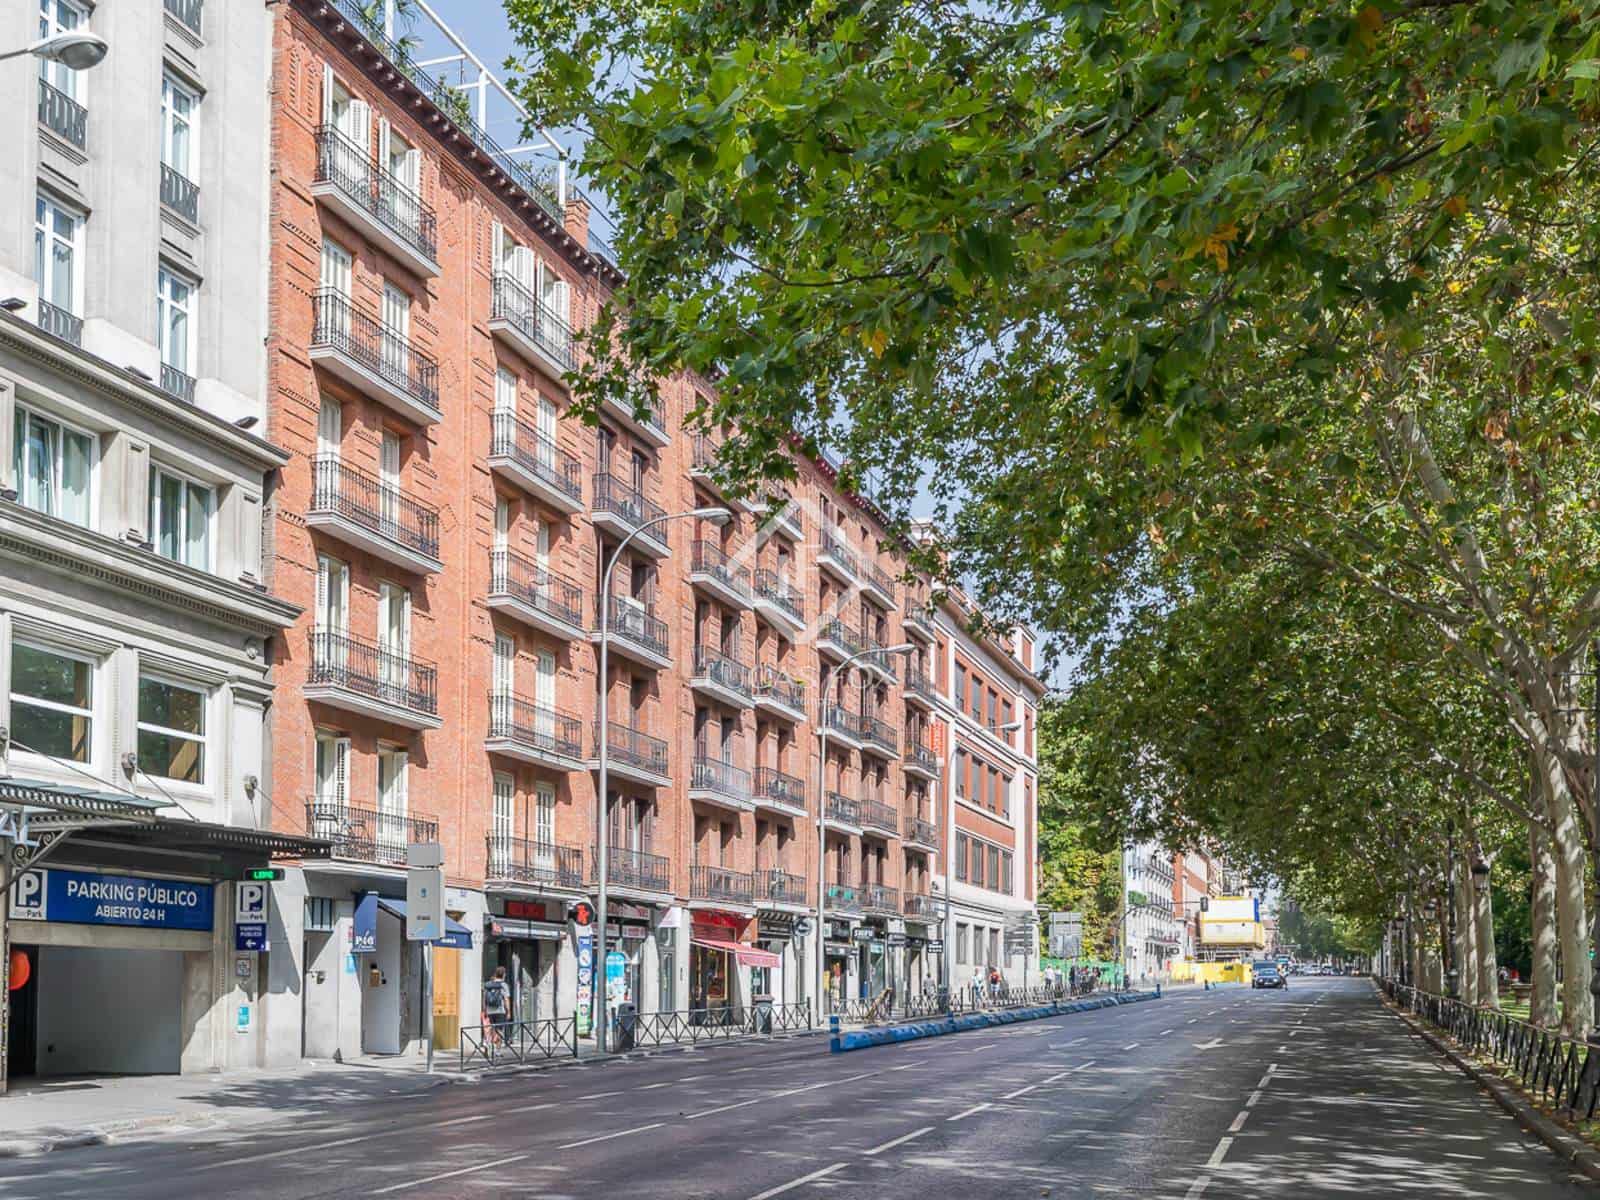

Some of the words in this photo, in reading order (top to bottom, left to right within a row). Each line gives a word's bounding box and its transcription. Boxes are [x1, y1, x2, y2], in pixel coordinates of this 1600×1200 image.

[67, 880, 134, 902] PARKING
[137, 884, 198, 907] PÚBLICO
[95, 904, 142, 919] ABIERTO
